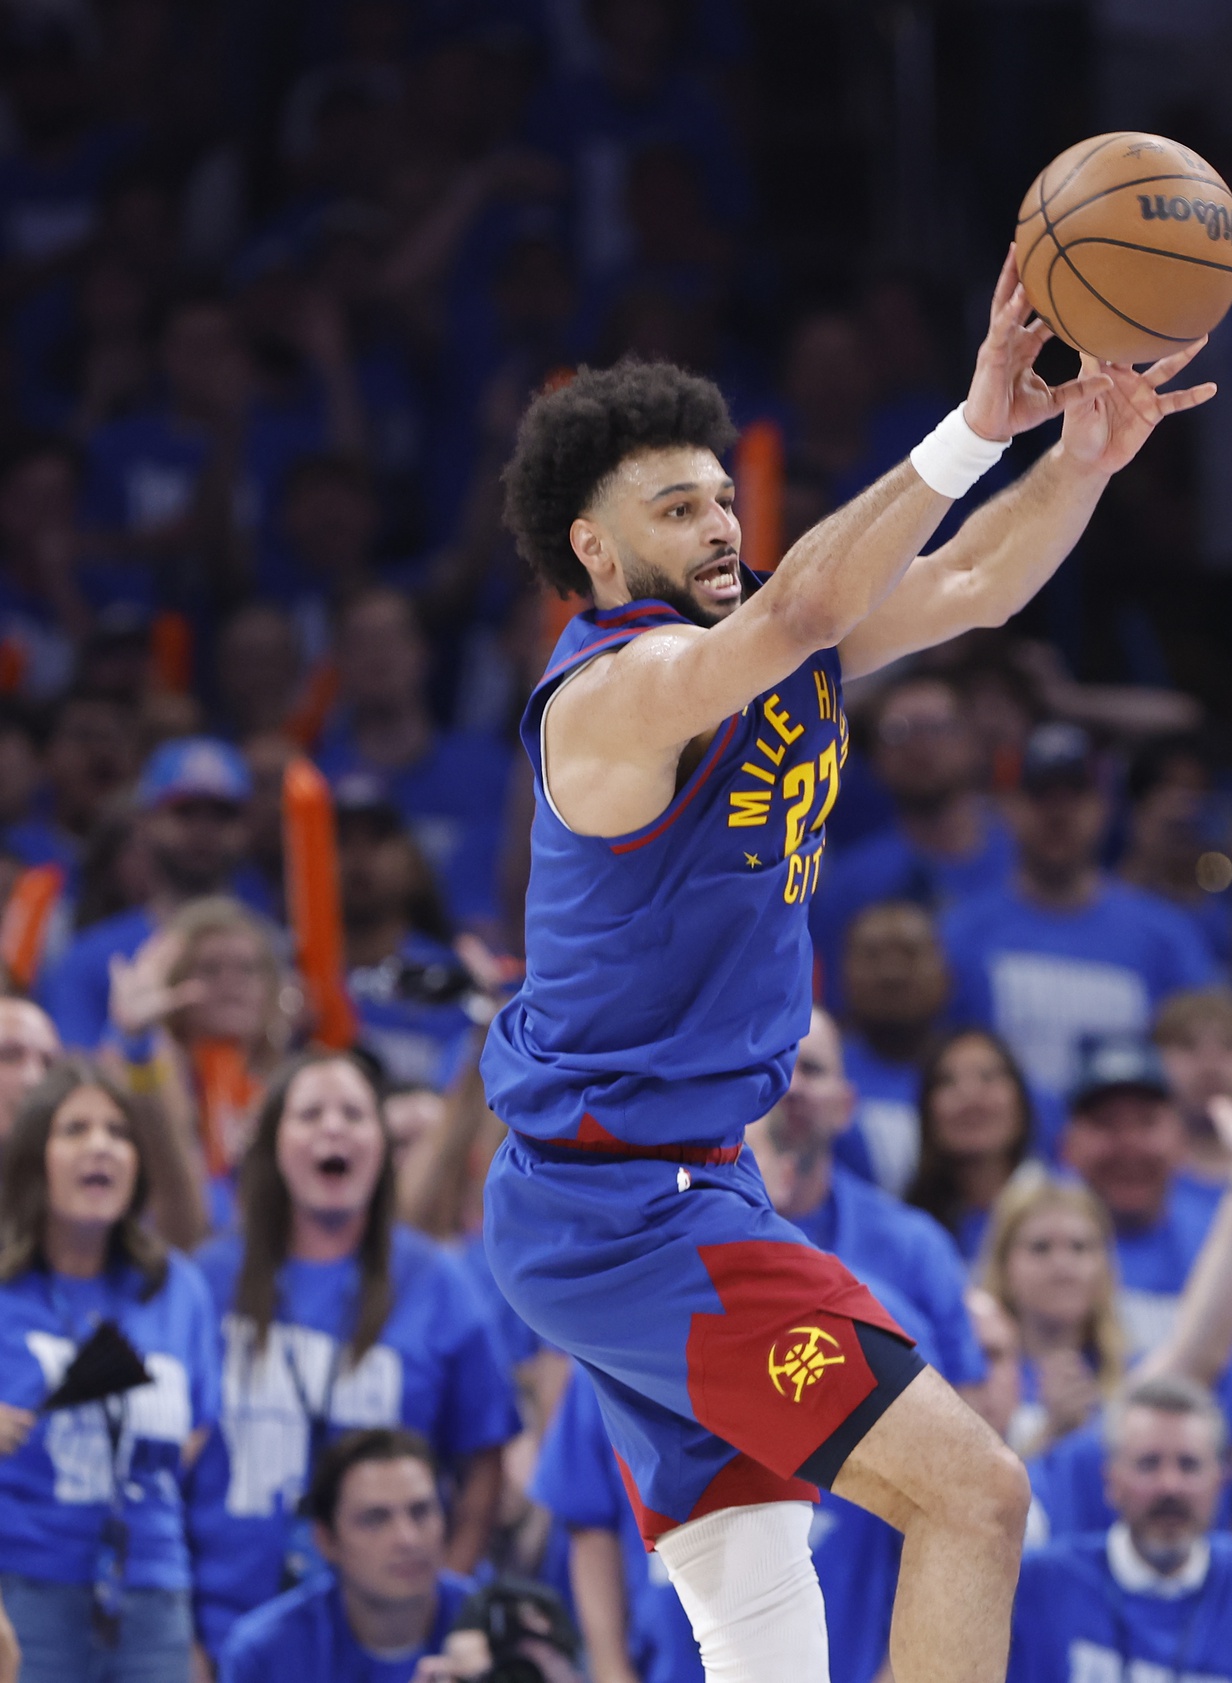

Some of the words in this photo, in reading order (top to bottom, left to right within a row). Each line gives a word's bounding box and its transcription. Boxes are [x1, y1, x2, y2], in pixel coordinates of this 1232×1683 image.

[728, 693, 805, 828] MILE
[783, 738, 839, 858] 27
[783, 837, 827, 904] CIT
